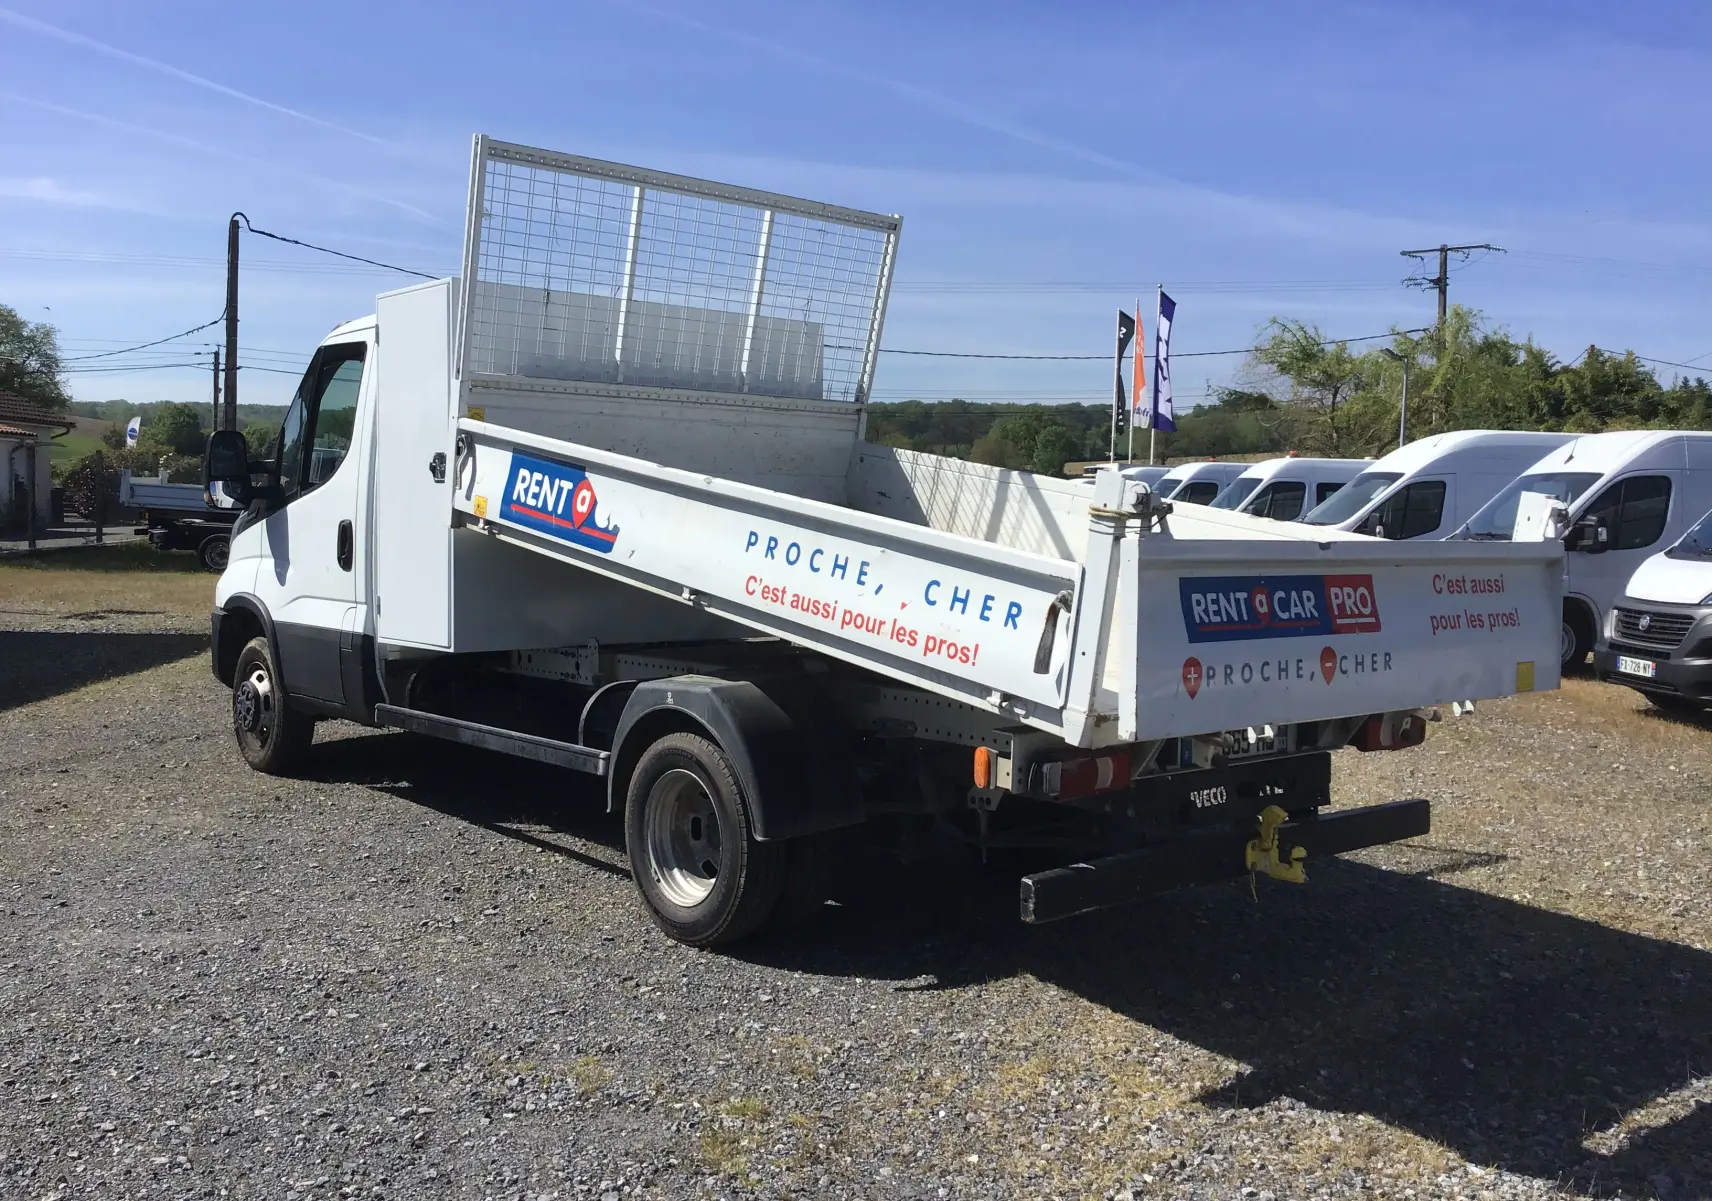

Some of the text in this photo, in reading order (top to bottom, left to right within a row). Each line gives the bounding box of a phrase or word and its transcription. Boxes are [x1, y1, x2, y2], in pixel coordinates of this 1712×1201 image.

[512, 467, 573, 515] RENT
[576, 488, 592, 513] a
[745, 530, 1023, 630] PROCHE, CHER
[1432, 573, 1505, 595] C'est aussi
[745, 575, 980, 667] C'est aussi pour les pros!
[1191, 586, 1372, 624] RENT a CAR PRO
[1430, 607, 1521, 636] pour les pros!
[1339, 651, 1393, 676] CHER
